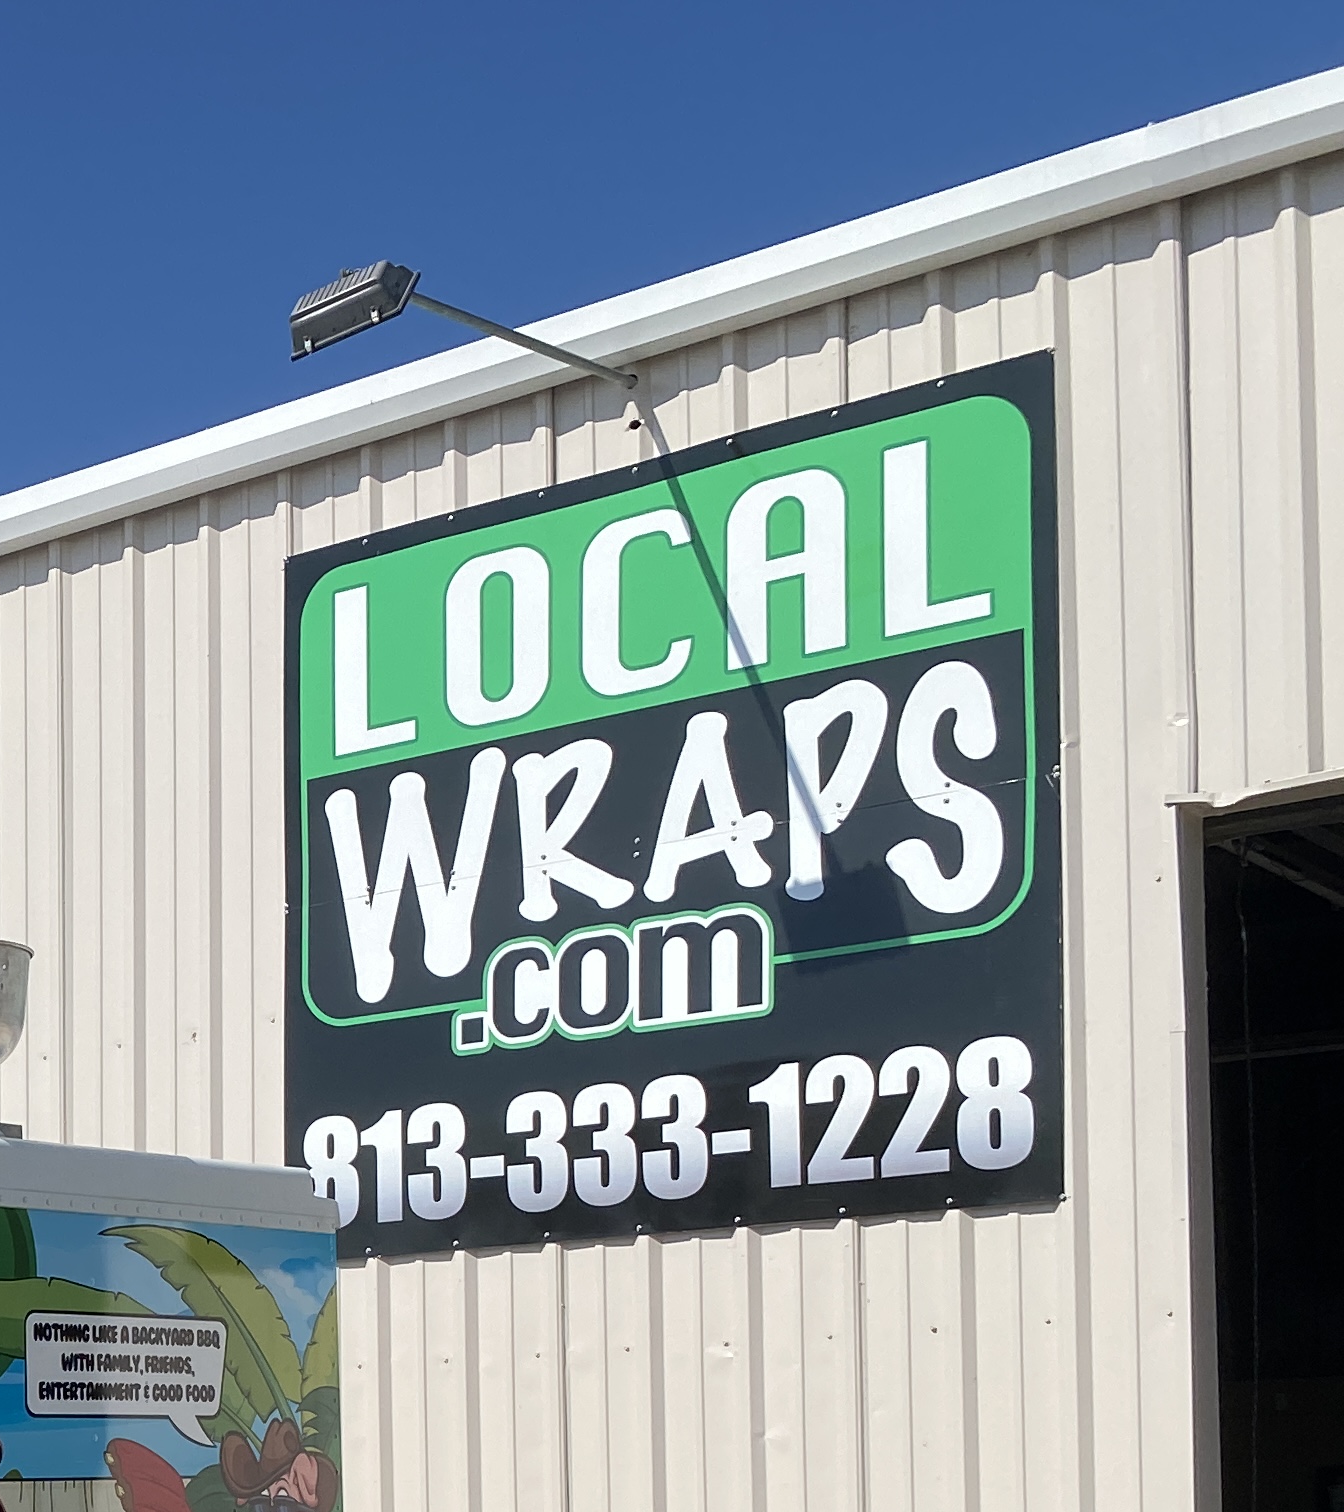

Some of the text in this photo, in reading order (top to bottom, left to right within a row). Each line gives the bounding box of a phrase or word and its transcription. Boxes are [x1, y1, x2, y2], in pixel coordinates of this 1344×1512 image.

[333, 439, 992, 757] LOCAL
[324, 660, 1005, 1004] WRAPS
[458, 910, 766, 1048] .com
[303, 1036, 1035, 1230] 813-333-1228
[33, 1322, 221, 1349] NOTHING LIKE A BACKYARD BBQ
[38, 1381, 141, 1402] ENTERTAINMENT
[152, 1383, 184, 1403] GOOD
[186, 1384, 216, 1403] FOOD
[61, 1353, 196, 1377] WITH FAMILY, FRIENDS,
